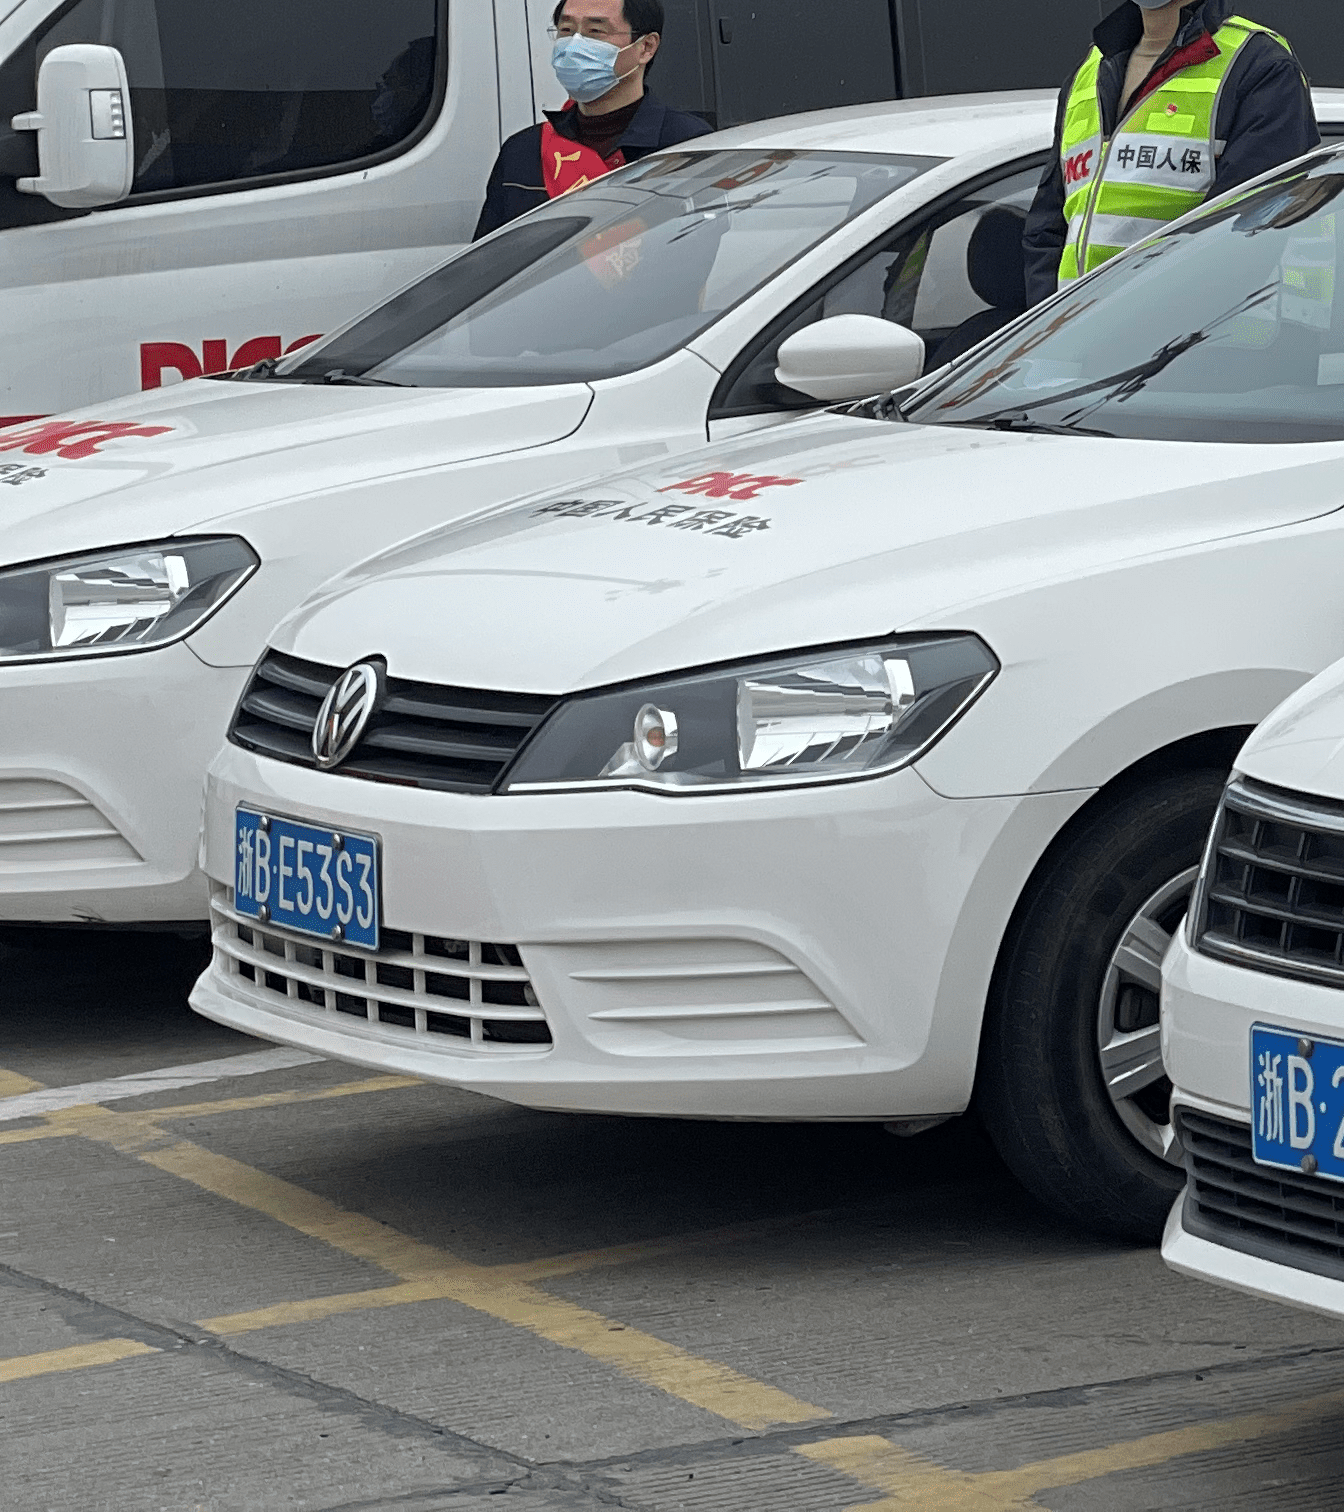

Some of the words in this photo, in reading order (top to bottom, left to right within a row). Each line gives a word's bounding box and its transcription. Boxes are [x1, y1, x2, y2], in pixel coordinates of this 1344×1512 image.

[1064, 148, 1094, 185] ICC
[1116, 143, 1201, 174] 中国人保
[654, 471, 807, 500] PICC
[528, 499, 772, 539] 中国人民保险
